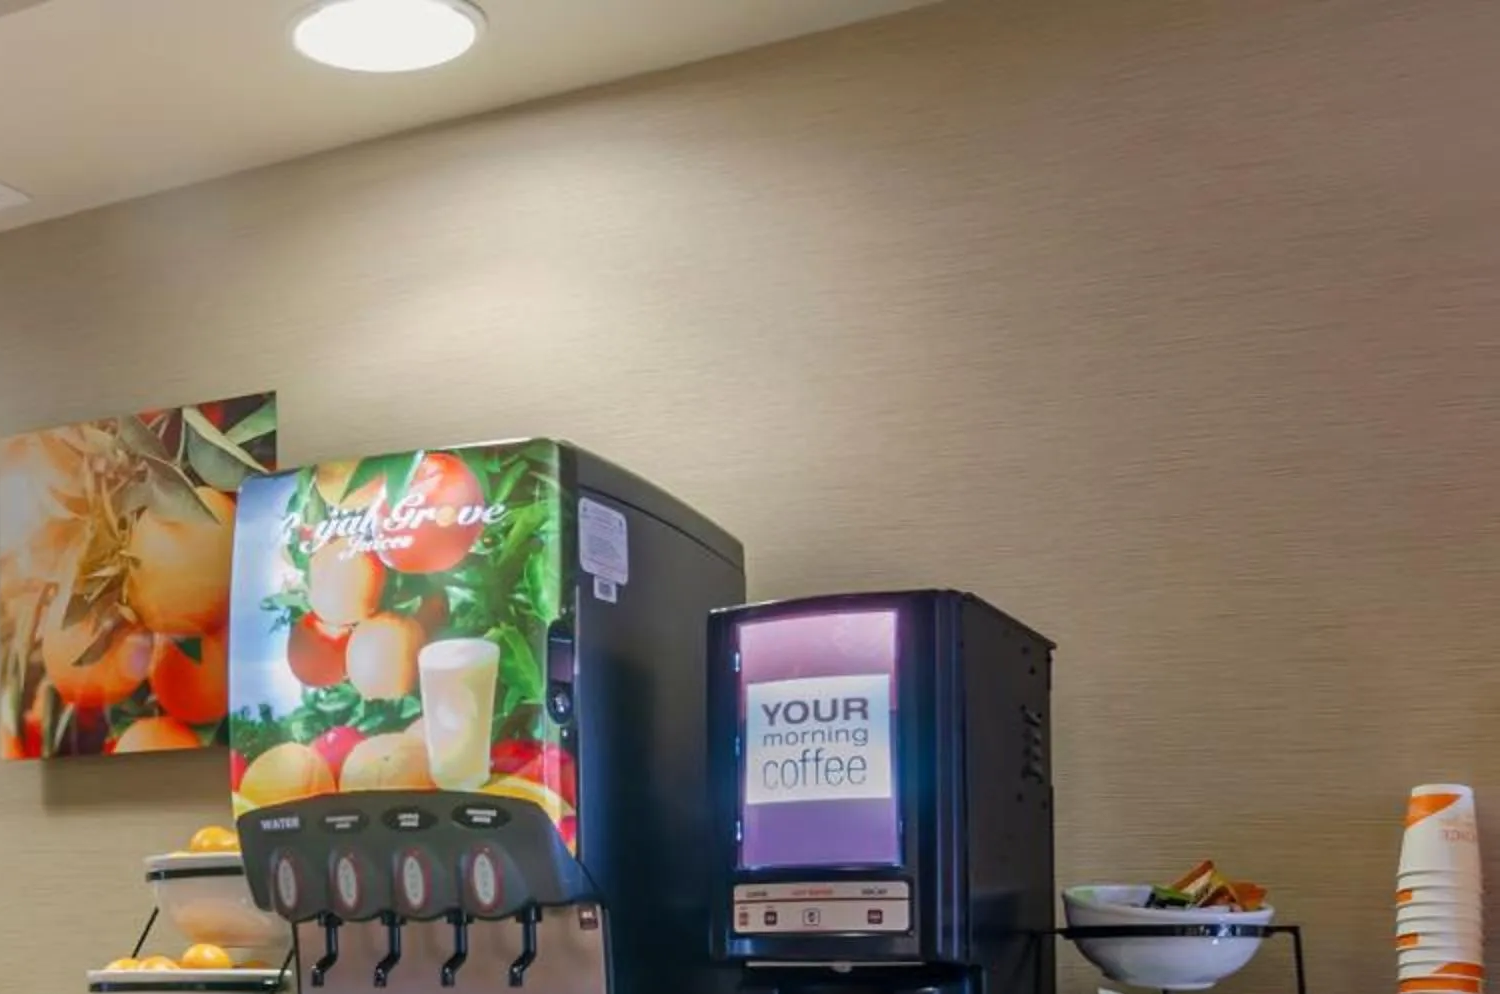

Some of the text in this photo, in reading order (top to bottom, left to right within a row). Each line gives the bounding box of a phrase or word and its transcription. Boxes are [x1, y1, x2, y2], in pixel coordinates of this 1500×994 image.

[383, 493, 507, 532] Grove
[761, 698, 869, 726] YOUR
[763, 728, 868, 747] morning
[763, 747, 868, 790] coffee
[260, 816, 300, 831] WATER
